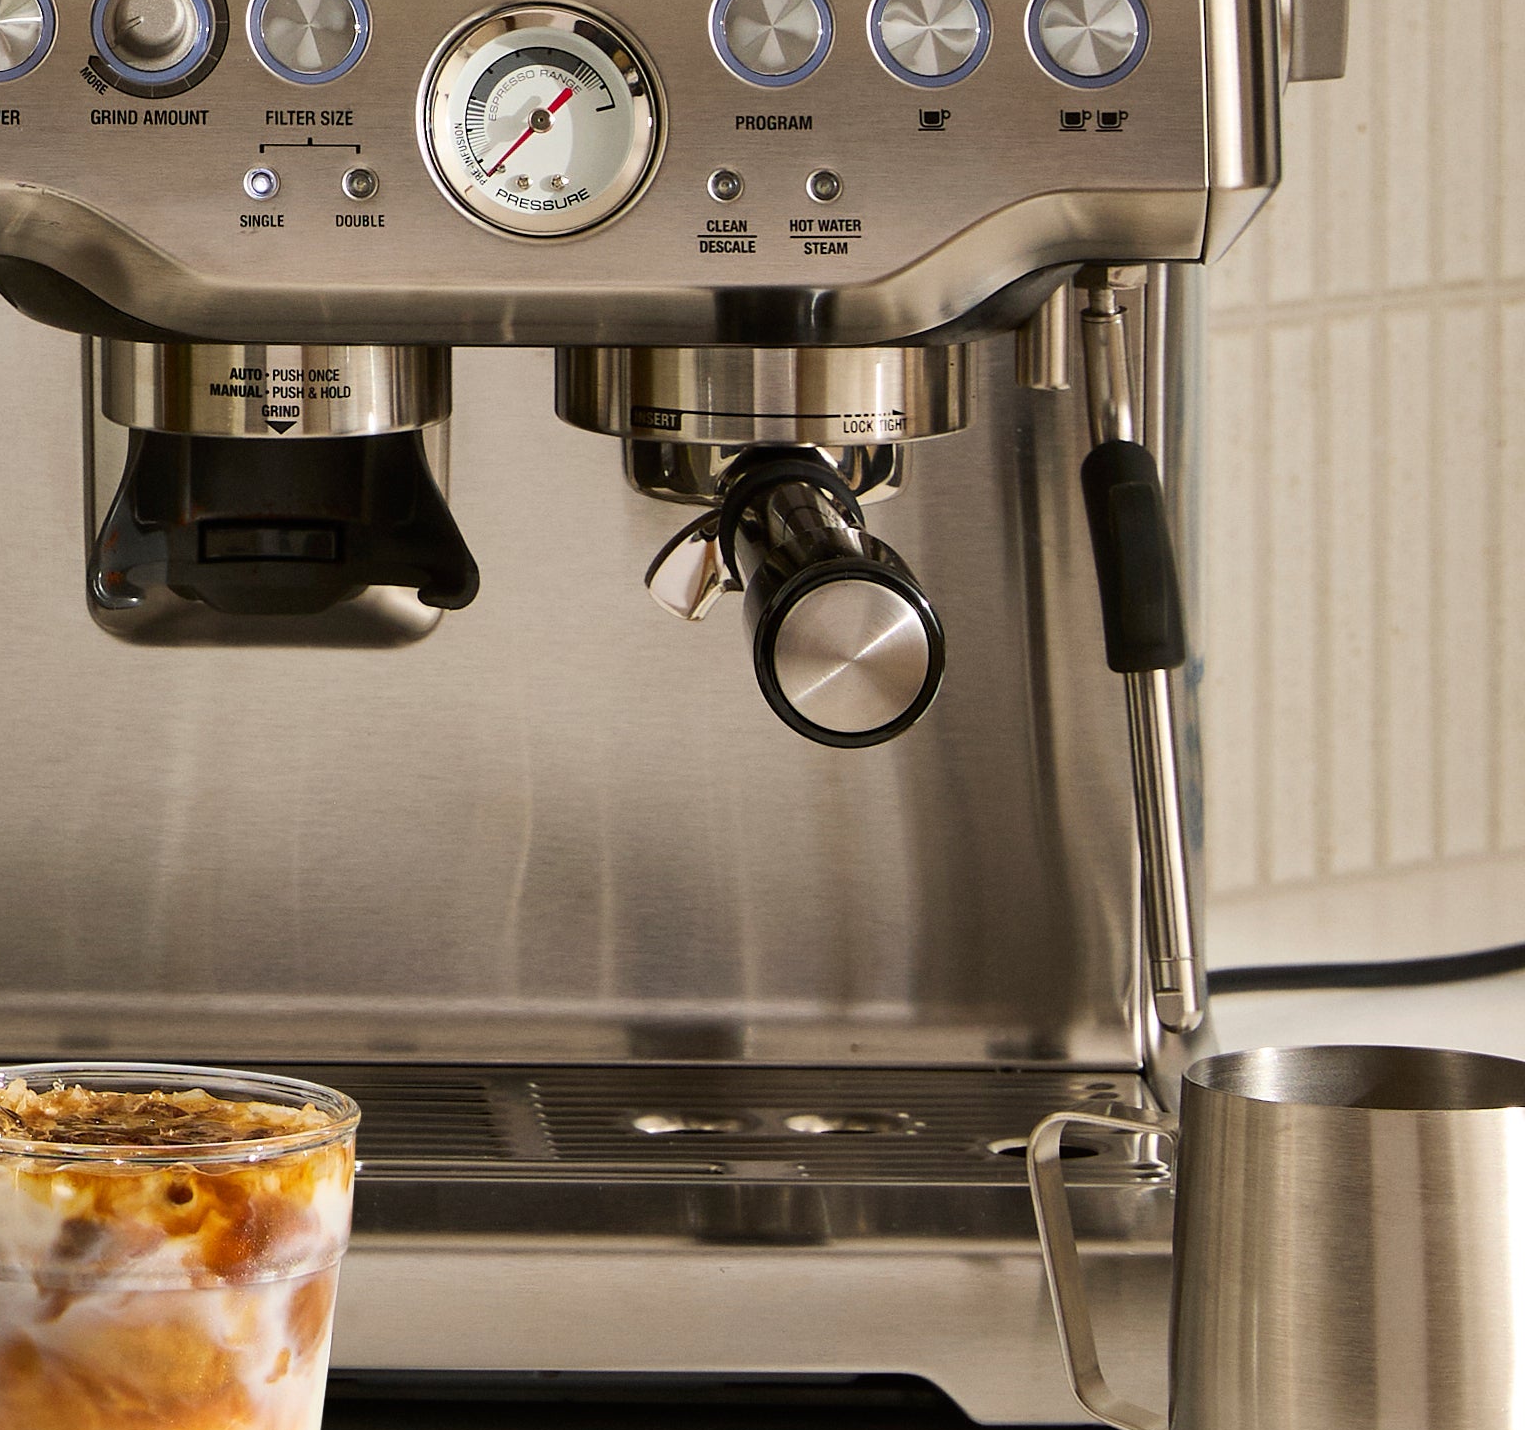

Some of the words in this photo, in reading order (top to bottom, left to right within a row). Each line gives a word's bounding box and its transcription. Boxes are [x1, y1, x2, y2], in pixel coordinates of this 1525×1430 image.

[79, 66, 109, 96] MORE
[489, 70, 535, 121] ESPRESSO
[540, 70, 582, 95] RANGE
[90, 109, 138, 125] GRIND
[143, 109, 209, 125] AMOUNT
[265, 110, 315, 126] FILTER
[320, 110, 354, 126] SIZE
[735, 115, 813, 130] PROGRAM
[454, 123, 487, 185] PRE-INFUSION
[496, 188, 590, 211] PRESSURE
[239, 214, 285, 228] SINGLE
[335, 214, 385, 228] DOUBLE
[706, 220, 748, 232] CLEAN
[789, 219, 814, 232] HOT
[818, 219, 861, 232] WATER
[699, 240, 756, 253] DESCALE
[804, 242, 848, 255] STEAM
[229, 367, 263, 380] AUTO
[272, 369, 303, 382] PUSH
[308, 368, 340, 382] ONCE
[209, 383, 263, 398] MANUAL
[272, 386, 303, 399] PUSH
[308, 387, 317, 399] &
[320, 386, 351, 398] HOLD
[261, 405, 300, 417] GRIND
[843, 420, 874, 433] LOCK
[880, 417, 907, 432] TIGHT
